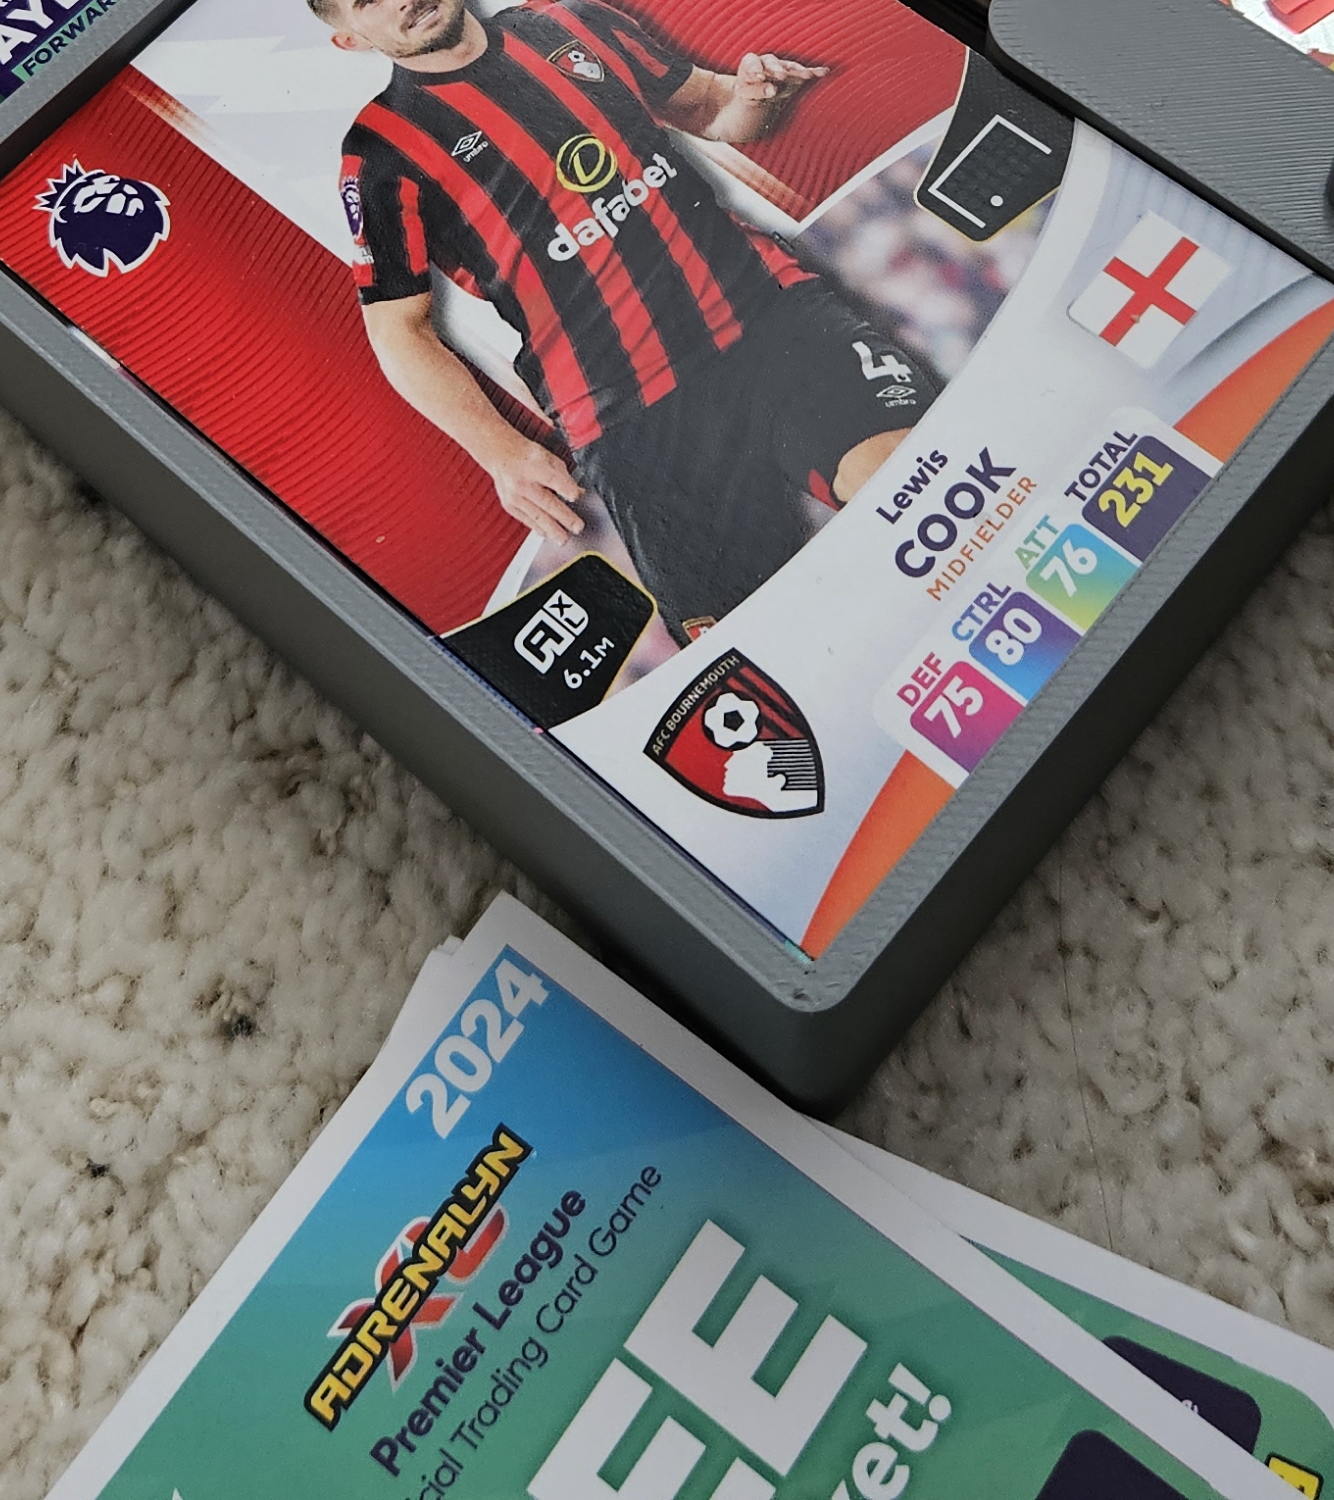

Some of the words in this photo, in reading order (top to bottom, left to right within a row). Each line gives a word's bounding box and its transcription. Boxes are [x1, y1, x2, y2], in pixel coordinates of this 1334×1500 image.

[547, 152, 678, 262] dafabet
[851, 340, 914, 383] 4
[875, 447, 948, 525] Lewis
[1064, 430, 1138, 502] TOTAL
[1098, 451, 1174, 528] 231
[894, 446, 1017, 578] COOK
[926, 475, 1037, 602] MIDFIELDER
[1013, 514, 1060, 570] ATT
[1039, 538, 1098, 598] 76
[951, 581, 1012, 642] CTRL
[985, 607, 1043, 666] 80
[652, 729, 670, 757] AFC
[665, 655, 741, 732] BOURNEMOUTH
[896, 651, 943, 707] DEF
[923, 675, 984, 739] 75
[404, 959, 548, 1139] 2024
[303, 1123, 534, 1431] ADRENALYN
[450, 1340, 549, 1452] Trading
[535, 1257, 599, 1336] Card
[588, 1163, 663, 1260] Game
[369, 1327, 487, 1478] Premier
[472, 1188, 587, 1331] League
